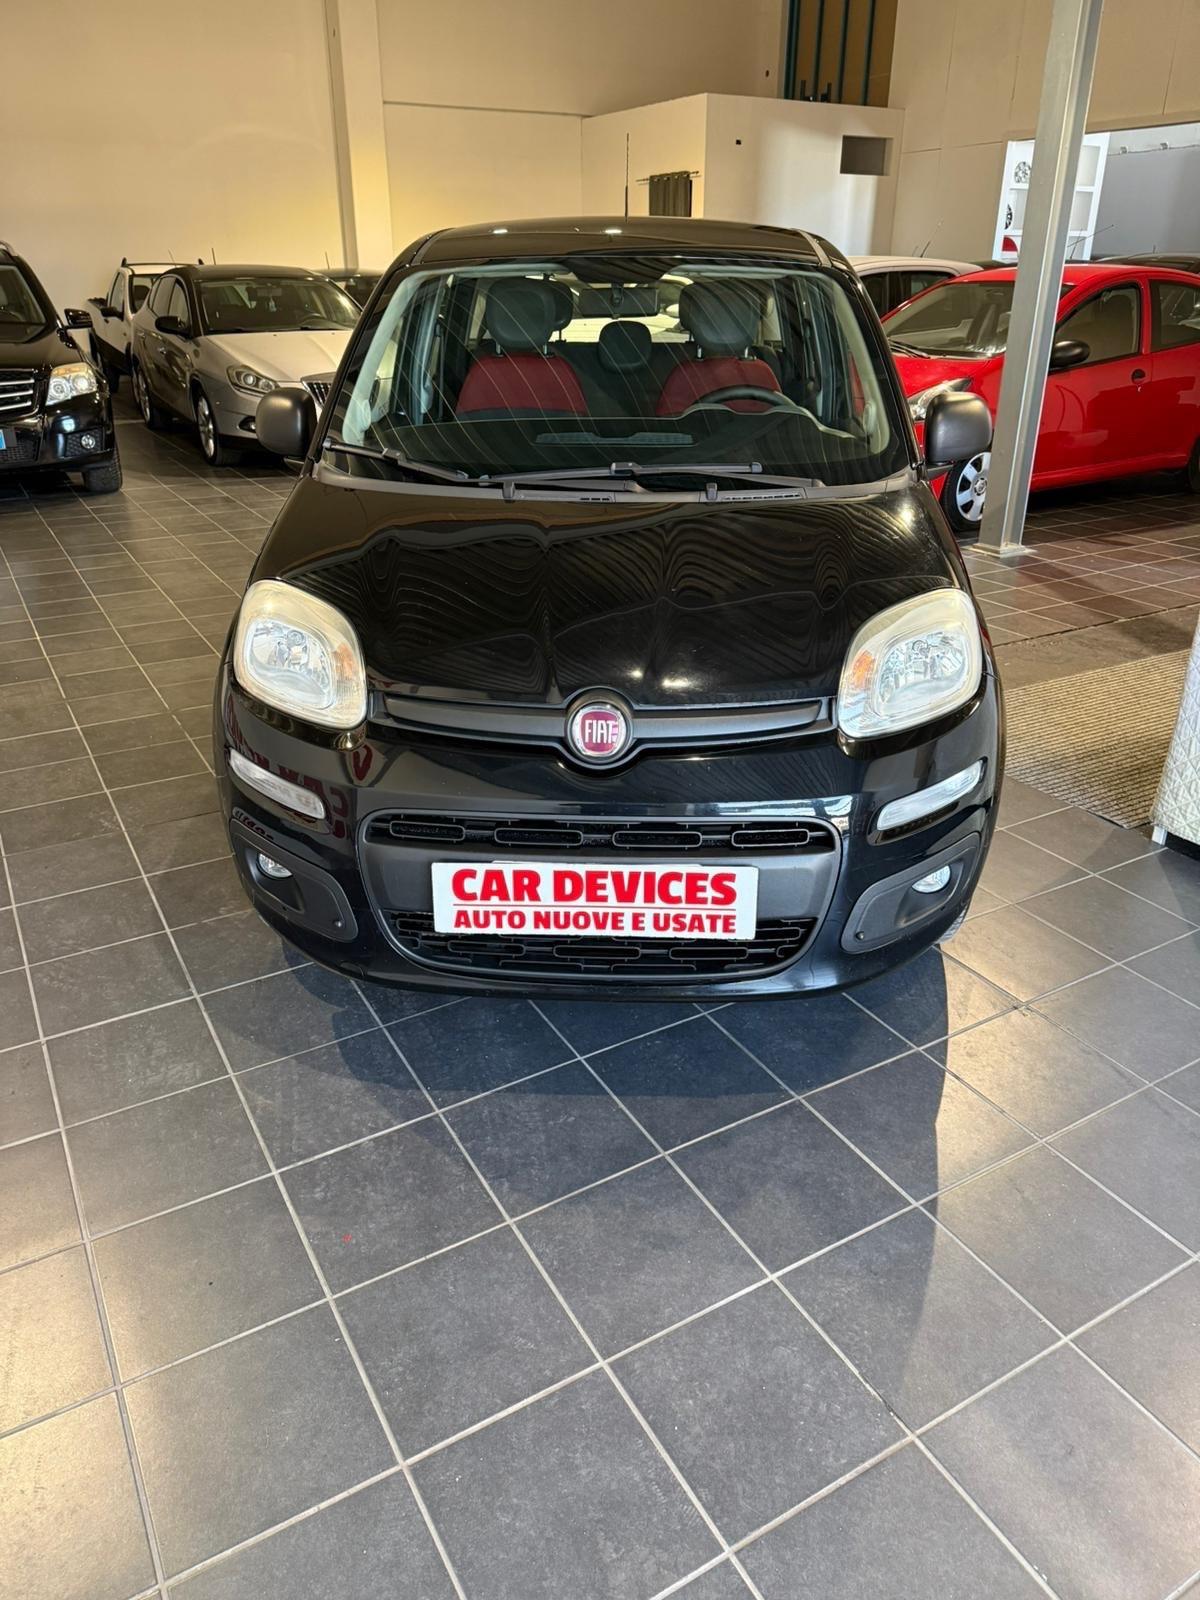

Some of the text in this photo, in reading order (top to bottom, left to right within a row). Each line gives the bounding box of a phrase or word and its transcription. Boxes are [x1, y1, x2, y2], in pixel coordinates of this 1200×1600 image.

[585, 719, 617, 744] FIAT
[452, 868, 737, 906] CAR DEVICES
[454, 909, 736, 934] AUTO NUOVE E USATE
